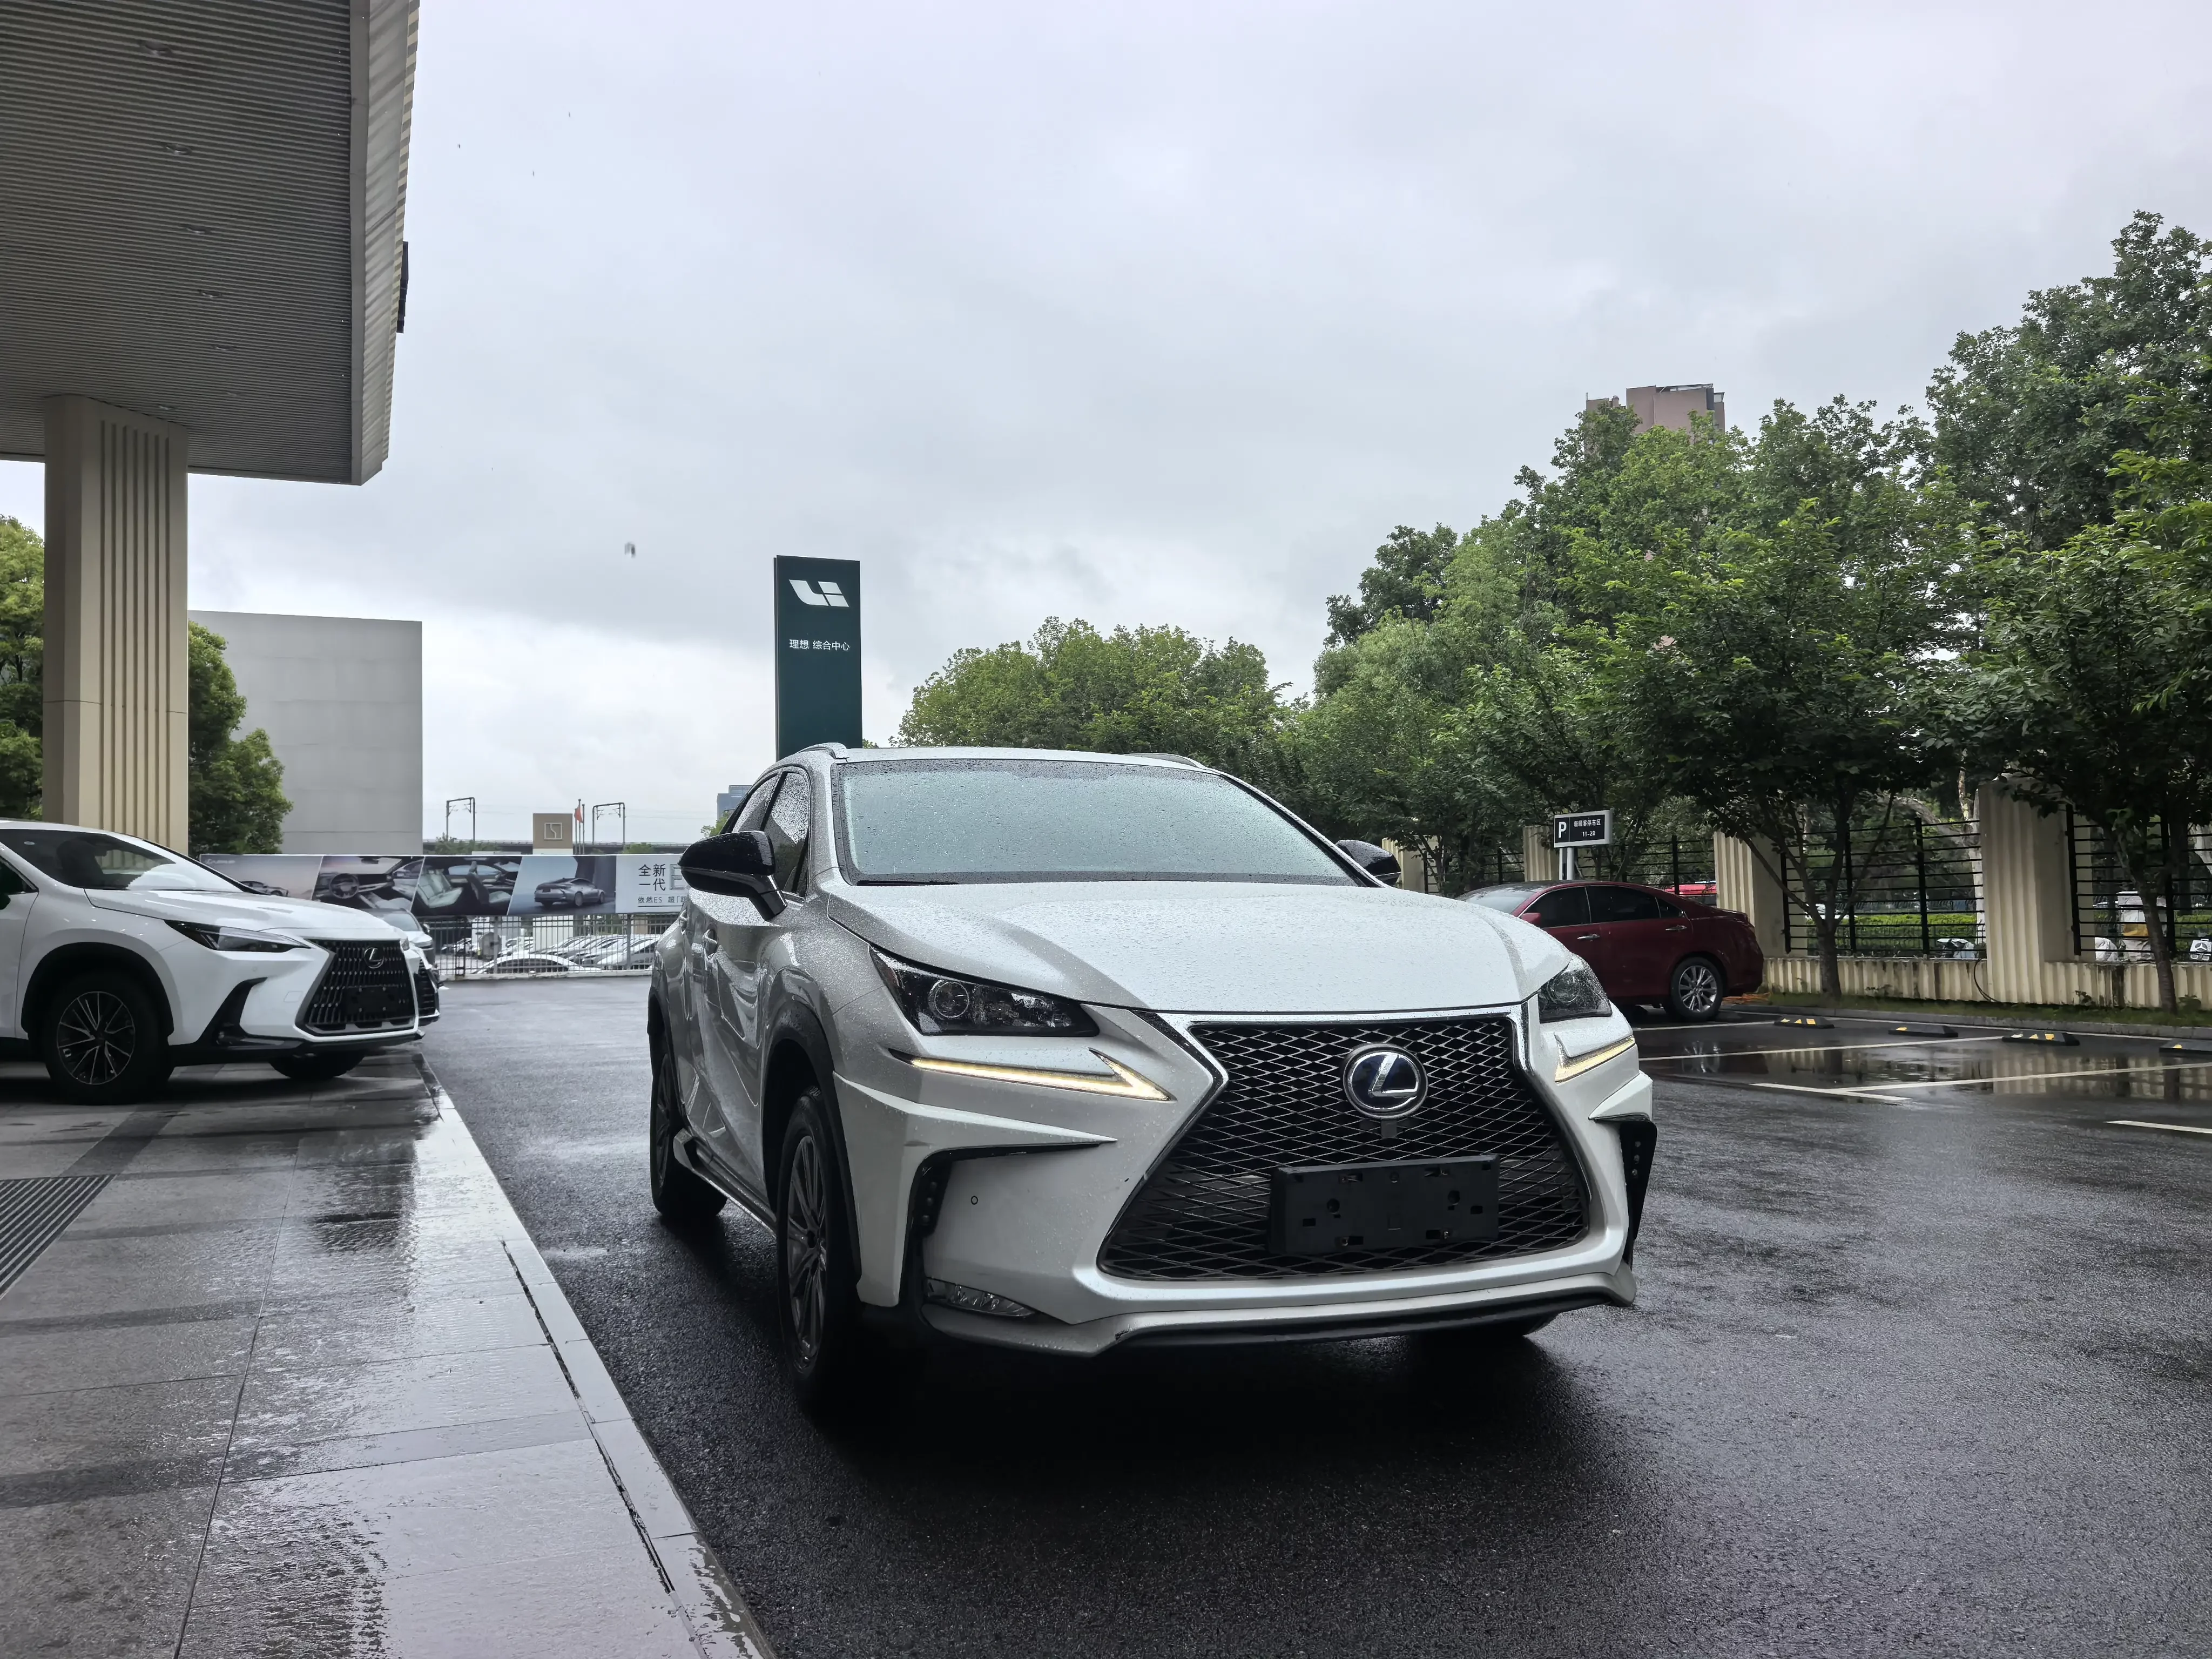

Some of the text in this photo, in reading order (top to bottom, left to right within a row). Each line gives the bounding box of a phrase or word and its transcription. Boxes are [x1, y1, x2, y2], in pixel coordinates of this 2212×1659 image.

[789, 639, 850, 651] 理想 综合中心
[1559, 821, 1567, 838] P
[638, 864, 666, 877] 全新
[639, 878, 666, 891] 一代
